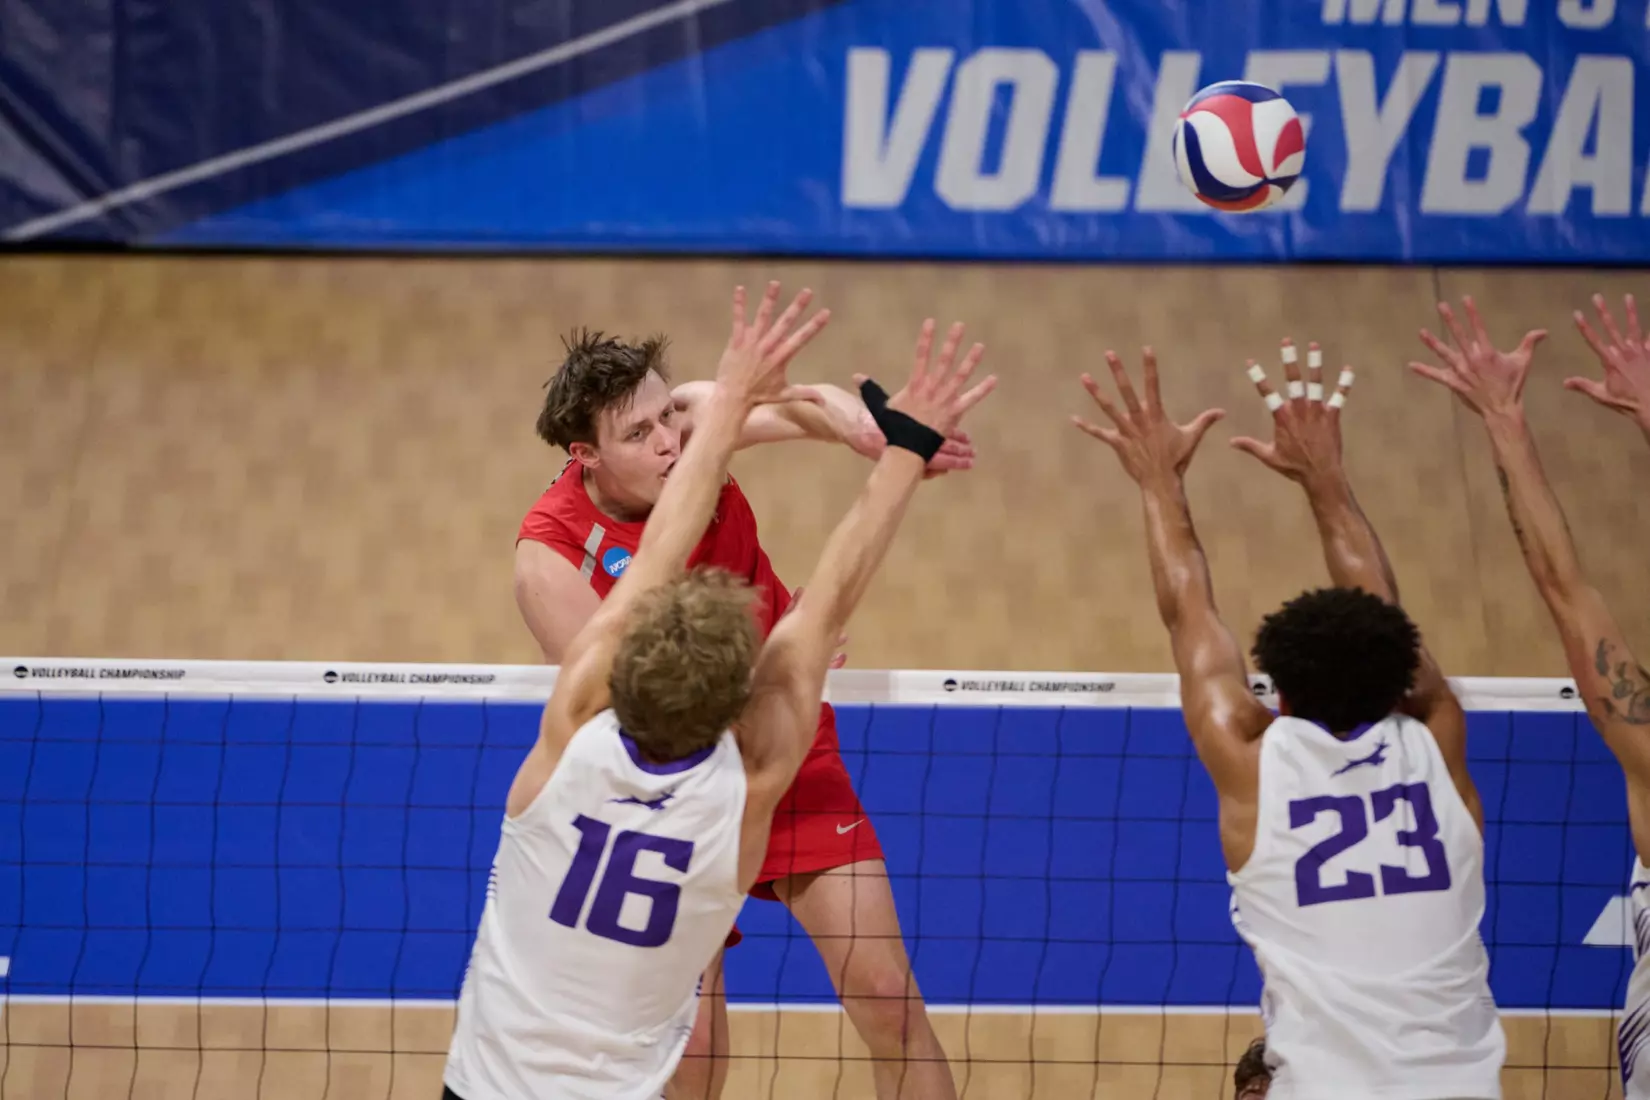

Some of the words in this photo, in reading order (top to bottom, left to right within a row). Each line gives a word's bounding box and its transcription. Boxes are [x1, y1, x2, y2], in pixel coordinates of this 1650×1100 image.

[841, 47, 1650, 217] VOLLYBA
[32, 667, 95, 679] VOLLEYBALL
[100, 668, 186, 680] CHAMPIONSHIP
[342, 672, 405, 684] VOLLEYBALL
[410, 673, 495, 685] CHAMPIONSHIP
[961, 680, 1024, 692] VOLLEYBALL
[1029, 681, 1115, 693] CHAMPIONSHIP
[1289, 781, 1451, 907] 23
[549, 813, 694, 948] 16
